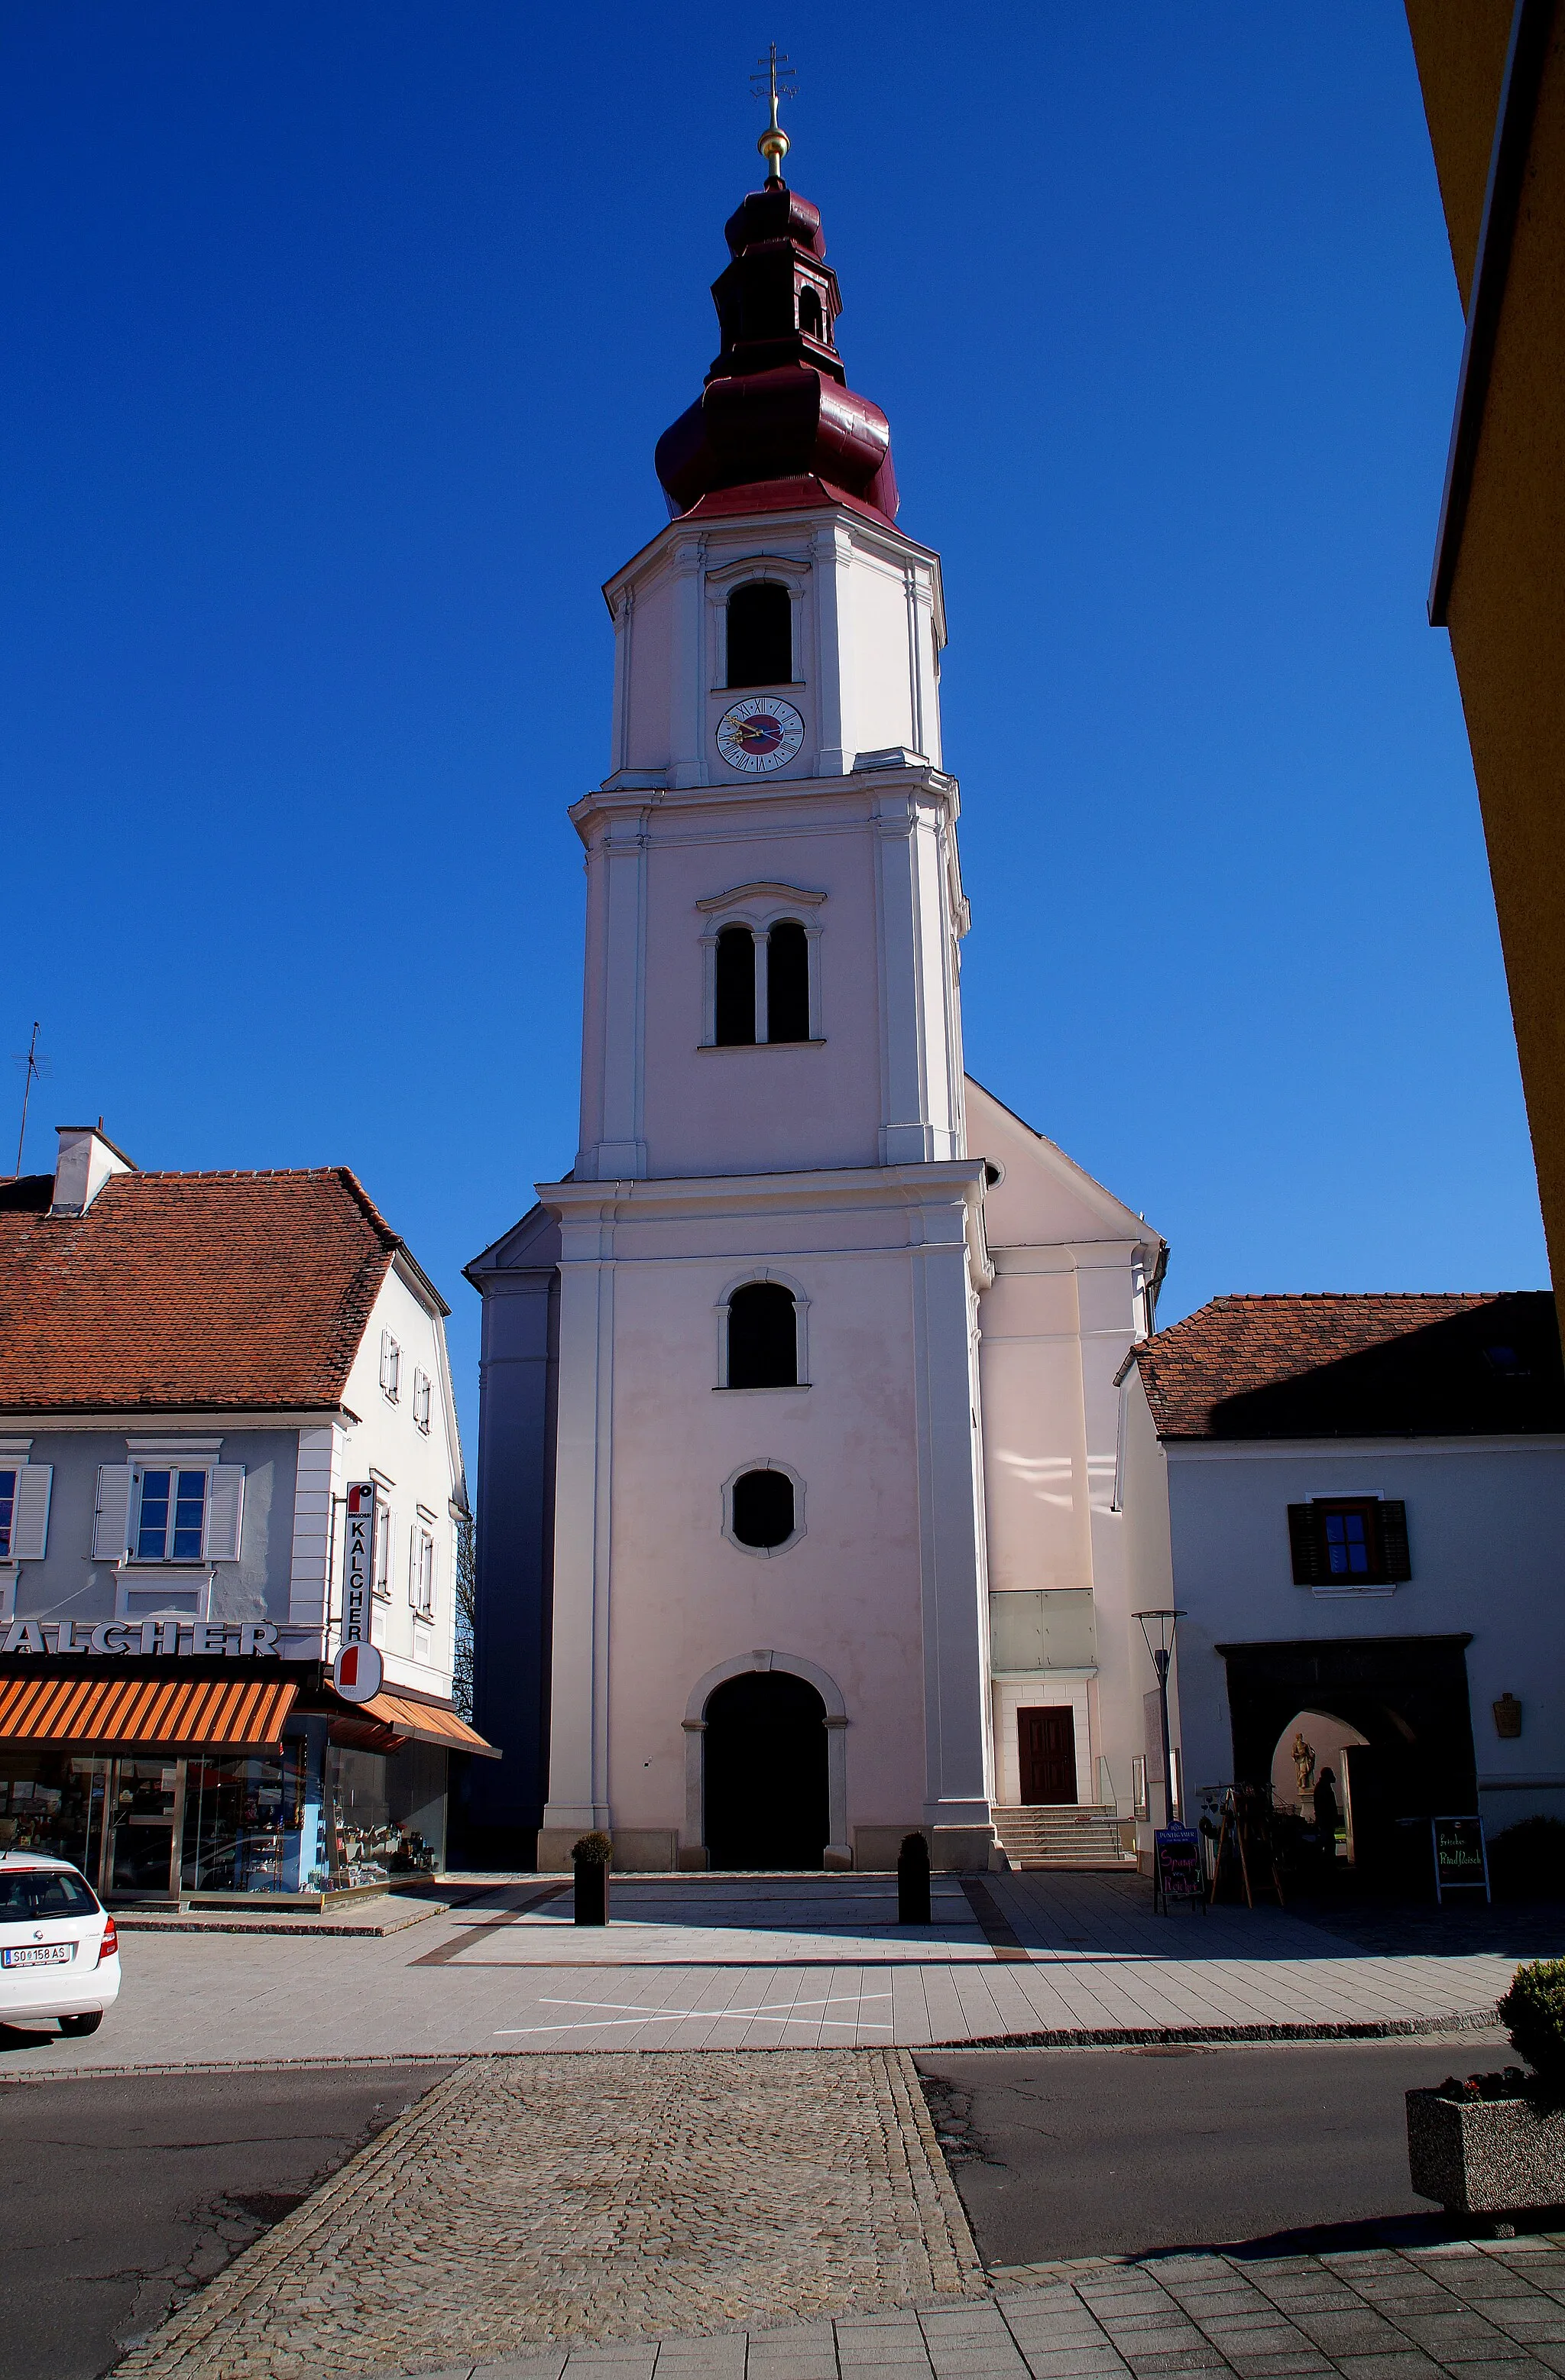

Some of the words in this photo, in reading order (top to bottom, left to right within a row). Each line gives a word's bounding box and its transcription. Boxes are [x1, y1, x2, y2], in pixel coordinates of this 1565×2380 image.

[754, 698, 766, 714] XII
[348, 1521, 366, 1641] KALCHER
[1, 1620, 281, 1656] ALCHER
[1440, 1849, 1482, 1867] Rindfleisch
[14, 1950, 26, 1962] SO
[34, 1948, 50, 1960] 158
[52, 1947, 65, 1959] AS
